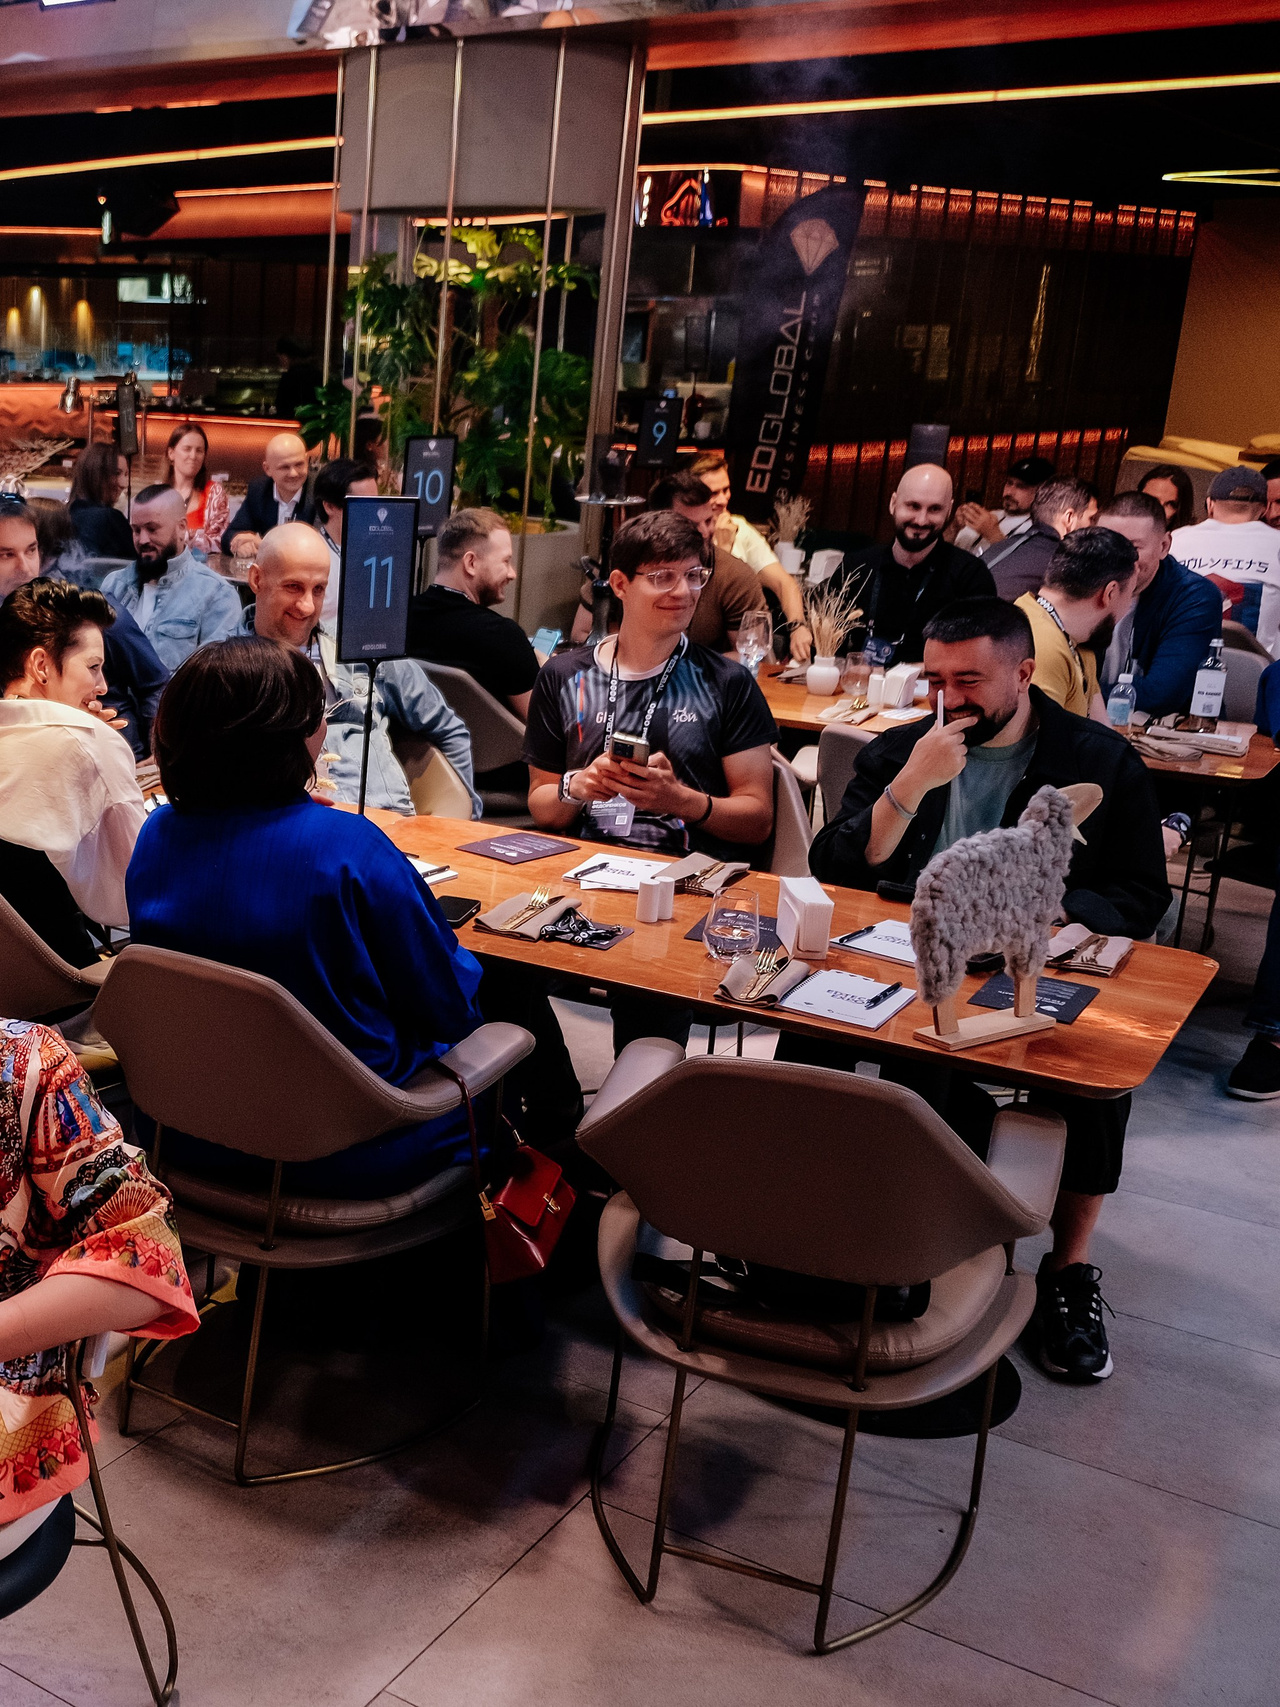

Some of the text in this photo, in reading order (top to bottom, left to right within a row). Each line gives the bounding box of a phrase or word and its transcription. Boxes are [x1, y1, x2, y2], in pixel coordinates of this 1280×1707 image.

[746, 291, 807, 494] EDGLOBAL
[652, 421, 667, 446] 9
[413, 469, 444, 505] 10
[363, 556, 393, 609] 11
